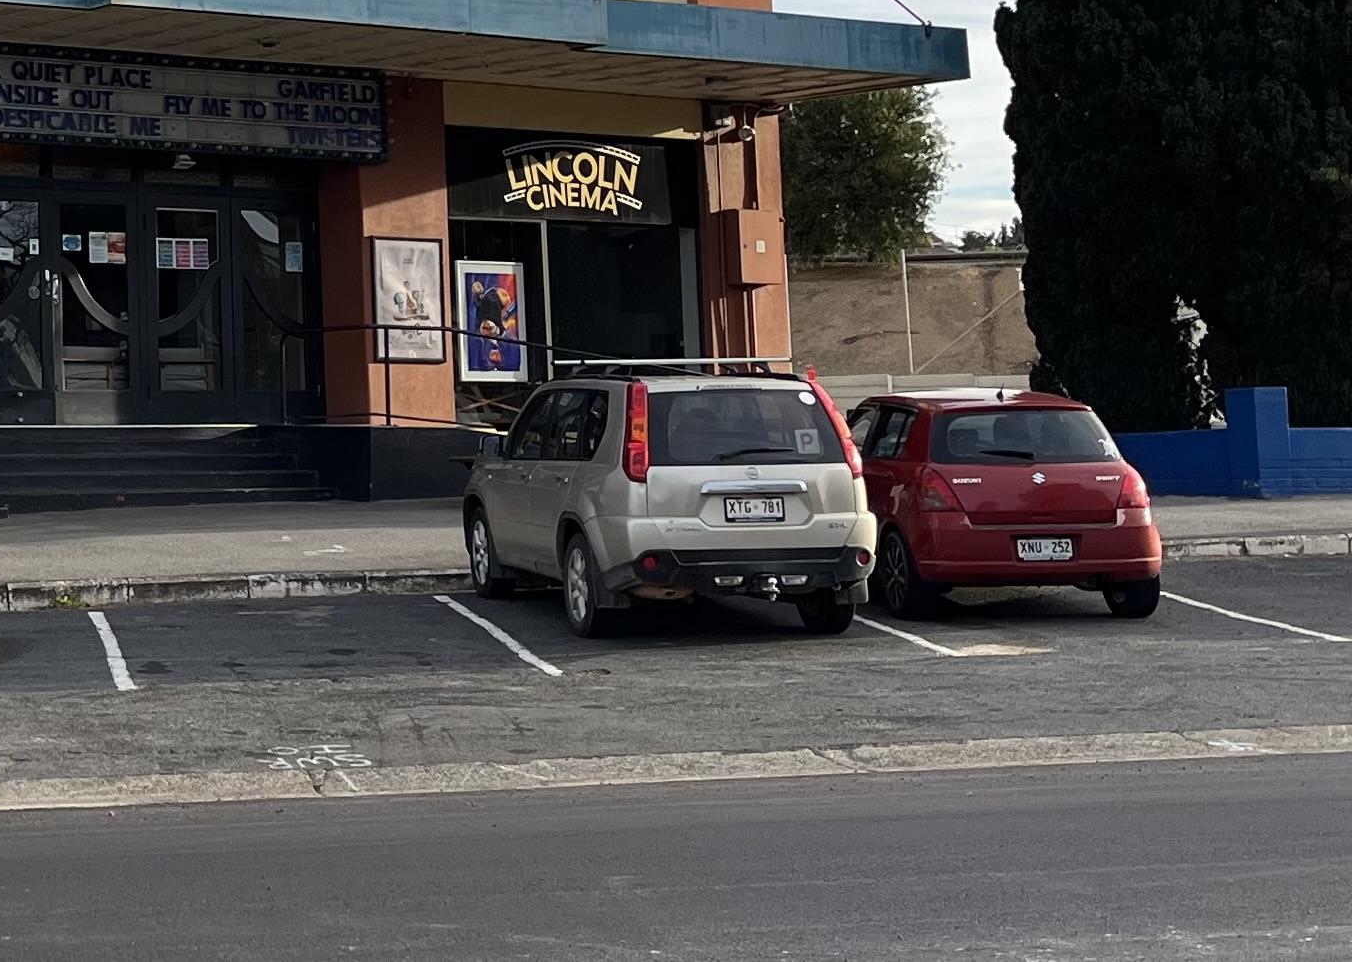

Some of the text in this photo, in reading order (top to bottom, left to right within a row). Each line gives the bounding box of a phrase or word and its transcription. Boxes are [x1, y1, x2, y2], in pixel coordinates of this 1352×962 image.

[11, 60, 74, 84] QUIET
[85, 66, 152, 90] PLACE
[70, 88, 114, 111] OUT
[278, 78, 377, 104] GARFIELD
[164, 94, 380, 126] FLY ME TO THE MOON
[129, 116, 162, 137] ME
[504, 151, 638, 196] LINCOLN
[525, 182, 619, 216] CINEMA
[728, 500, 780, 514] XTG 781
[1019, 541, 1070, 554] XNU 252
